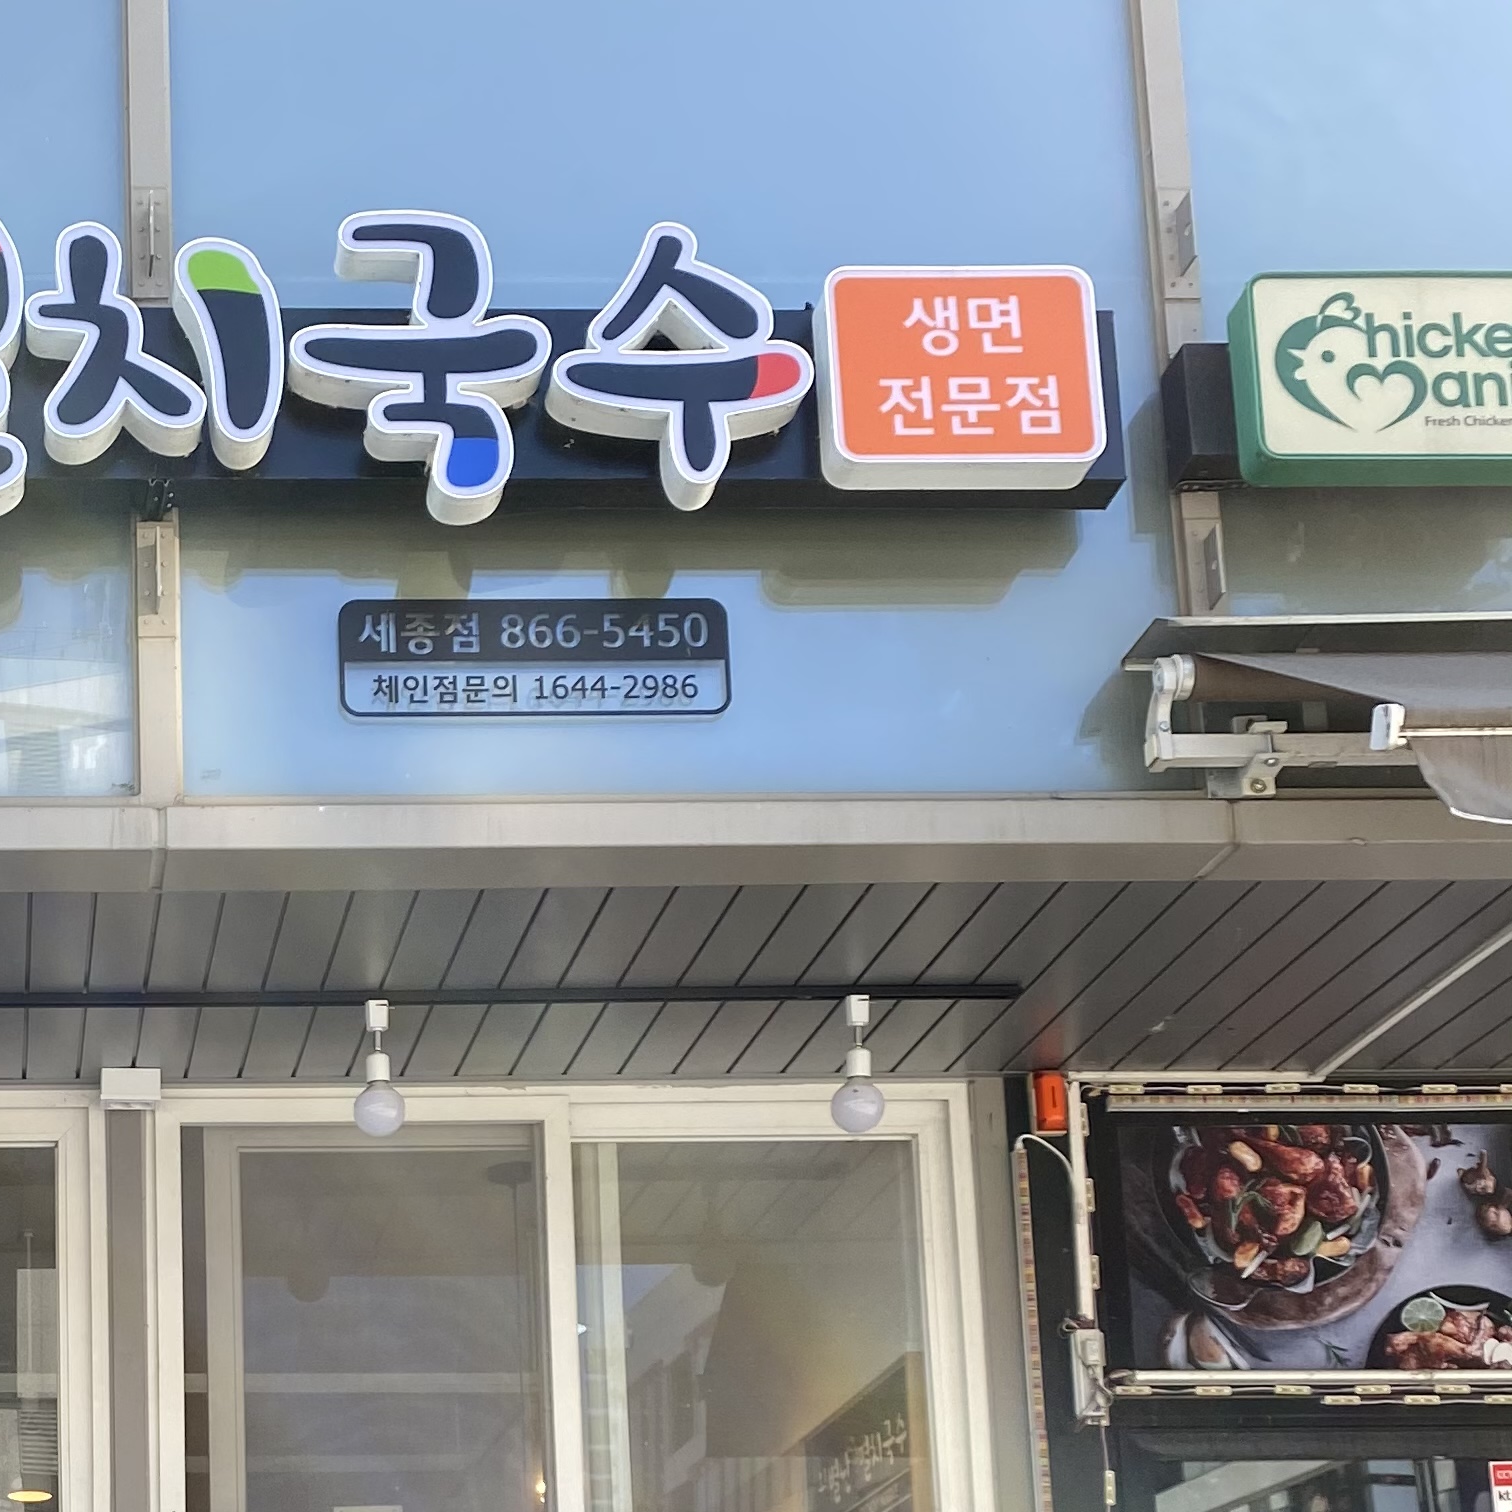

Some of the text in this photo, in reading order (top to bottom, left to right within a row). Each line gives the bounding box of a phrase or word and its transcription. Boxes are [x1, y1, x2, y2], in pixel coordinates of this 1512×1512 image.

[903, 296, 1024, 357] 생면
[878, 374, 1063, 437] 전문점
[1424, 416, 1461, 427] Fresh
[358, 611, 709, 656] 세종점 866-5450
[372, 673, 699, 706] 체인점문의 1644-2986
